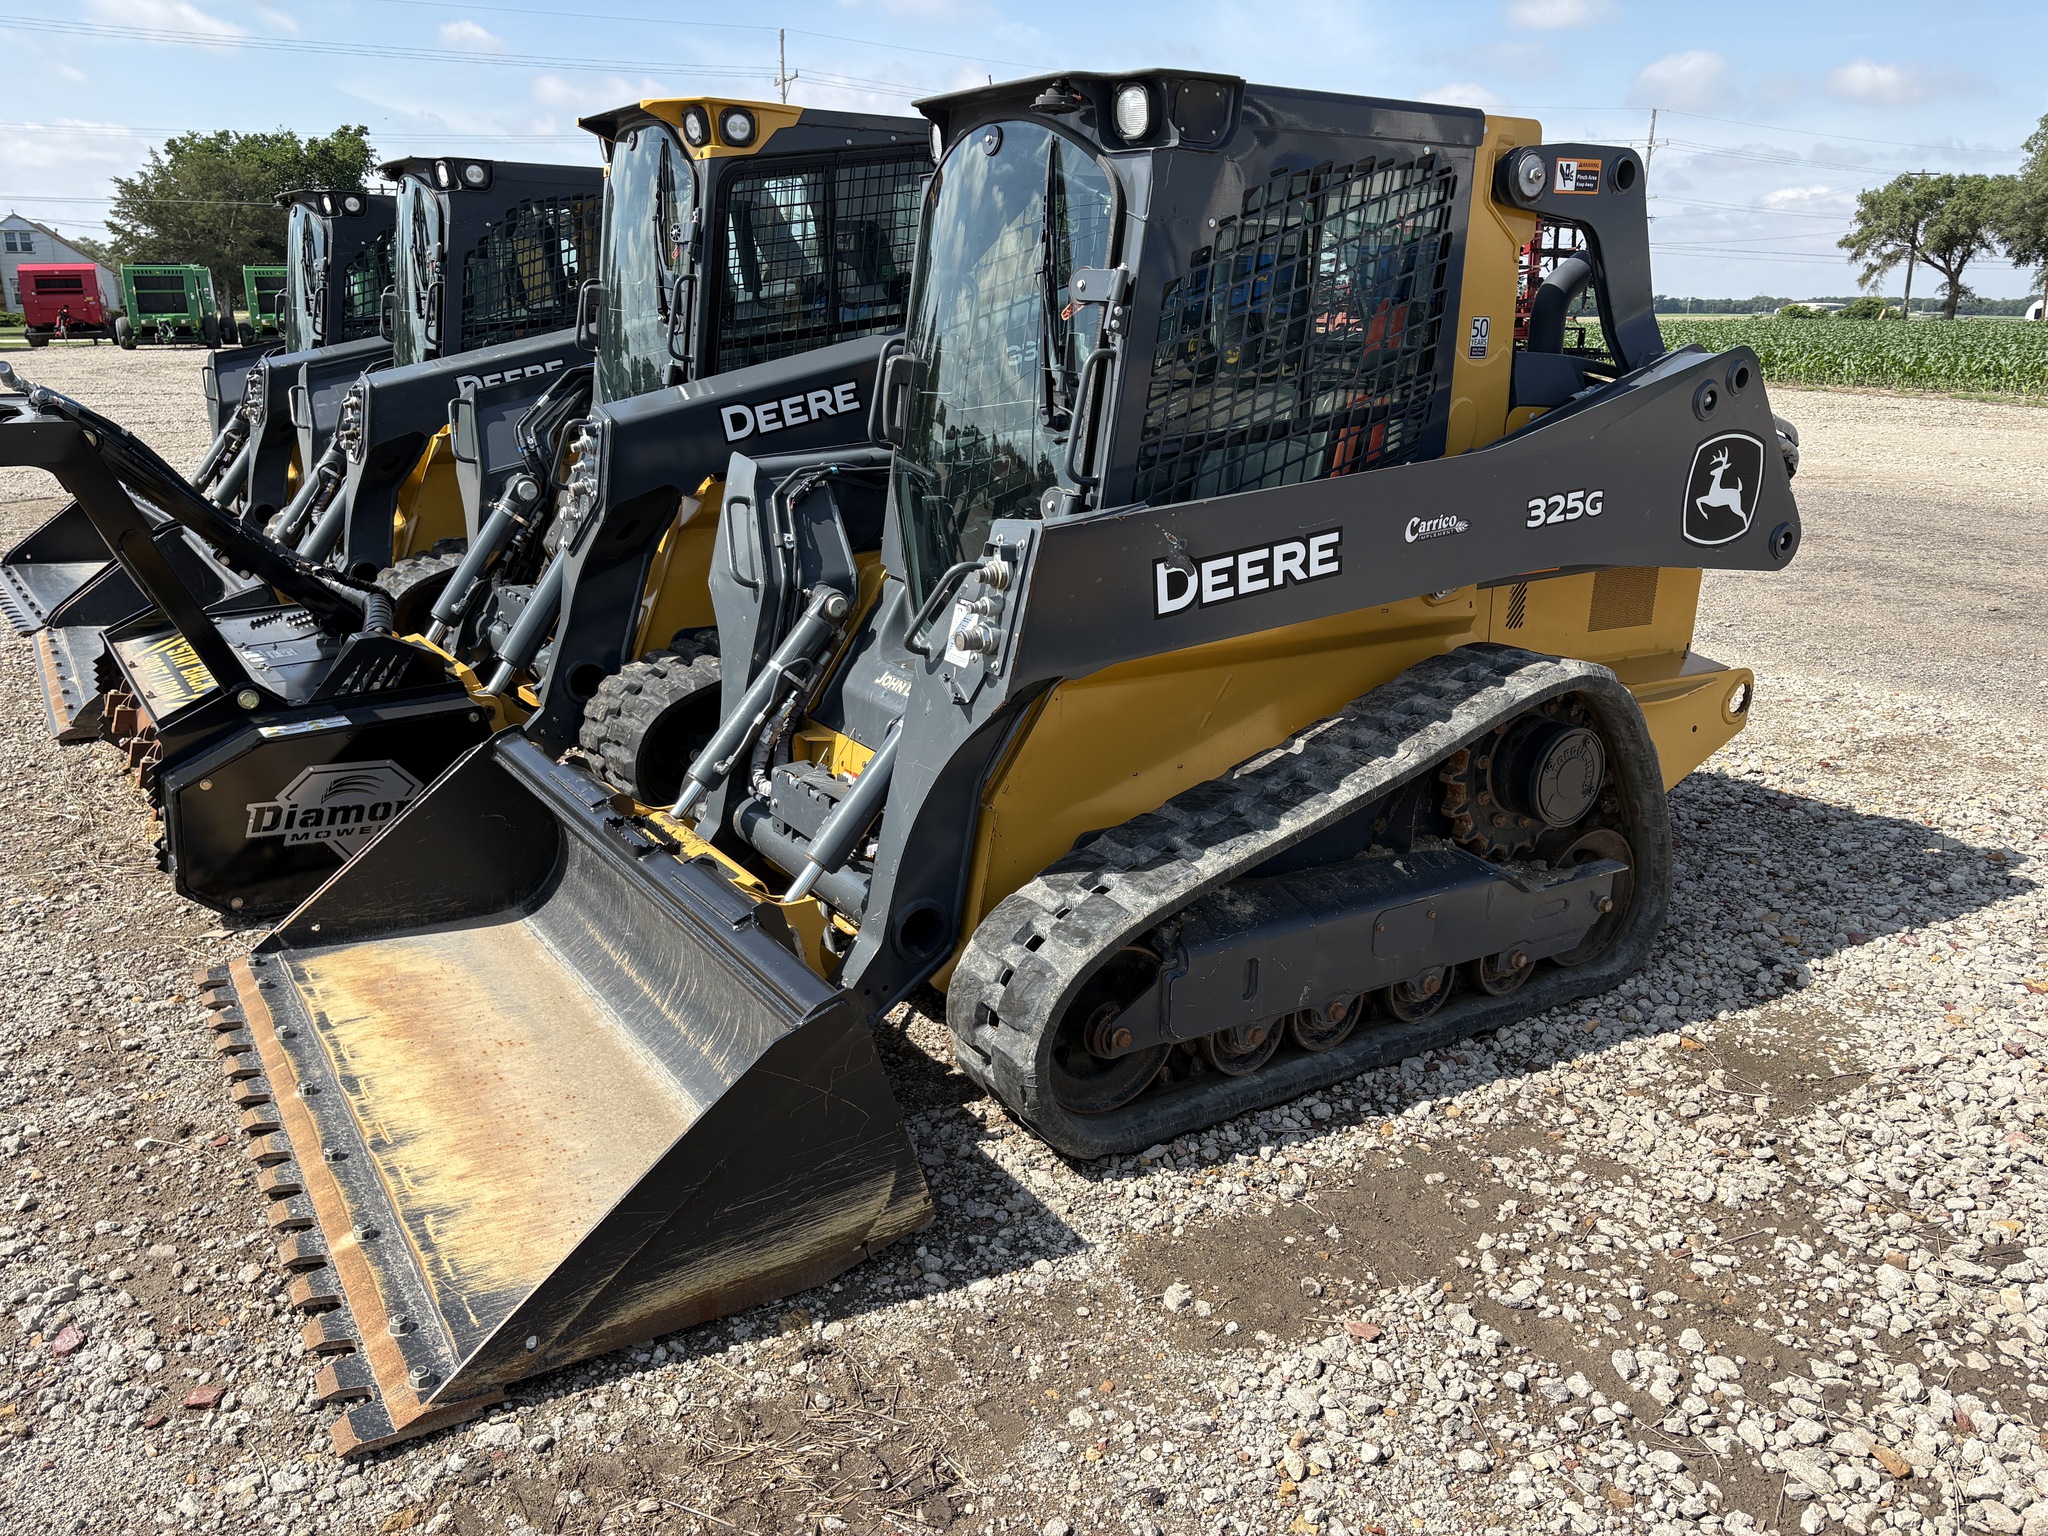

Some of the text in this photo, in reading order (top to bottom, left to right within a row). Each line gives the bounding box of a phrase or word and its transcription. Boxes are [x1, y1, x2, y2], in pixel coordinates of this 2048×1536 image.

[1471, 318, 1489, 338] 50
[1471, 338, 1487, 346] YEARS
[720, 381, 861, 442] DEERE
[1526, 489, 1604, 528] 325G
[1405, 513, 1457, 543] Carrico
[1418, 529, 1454, 541] IMPLEMENT
[1156, 531, 1340, 615] DEERE
[166, 643, 219, 693] STAY BACK
[874, 669, 906, 694] JOHN
